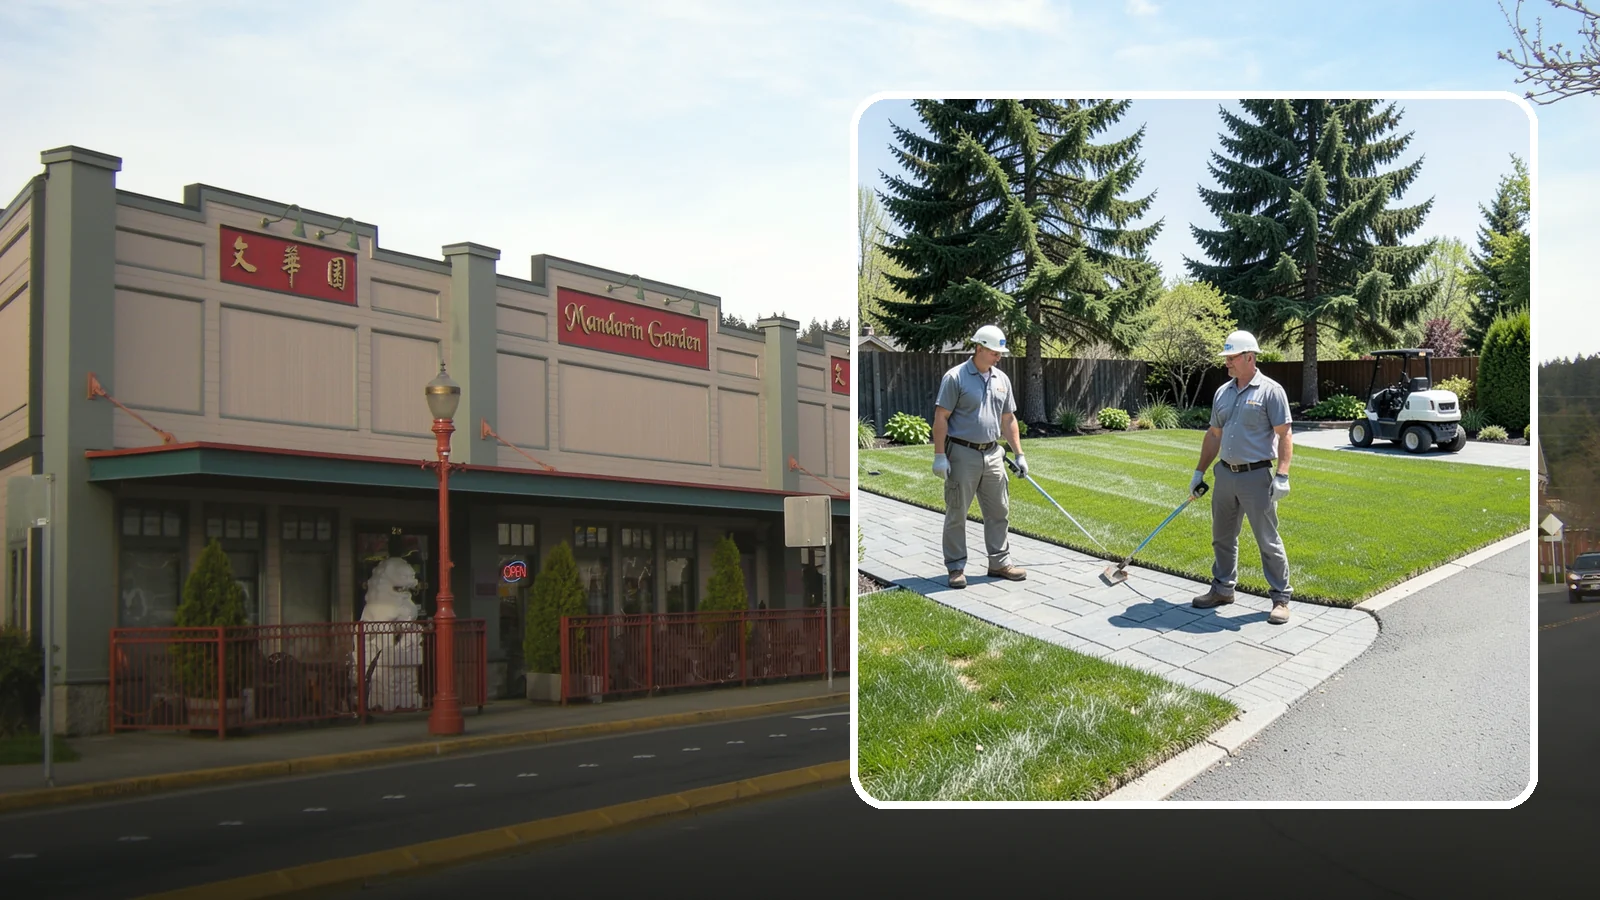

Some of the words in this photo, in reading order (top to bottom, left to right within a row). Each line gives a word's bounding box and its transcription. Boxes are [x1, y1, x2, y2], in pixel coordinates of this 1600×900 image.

[230, 235, 347, 291] 文華園
[564, 302, 644, 341] Mandarin
[647, 320, 702, 352] Garden
[503, 565, 527, 578] OPEN
